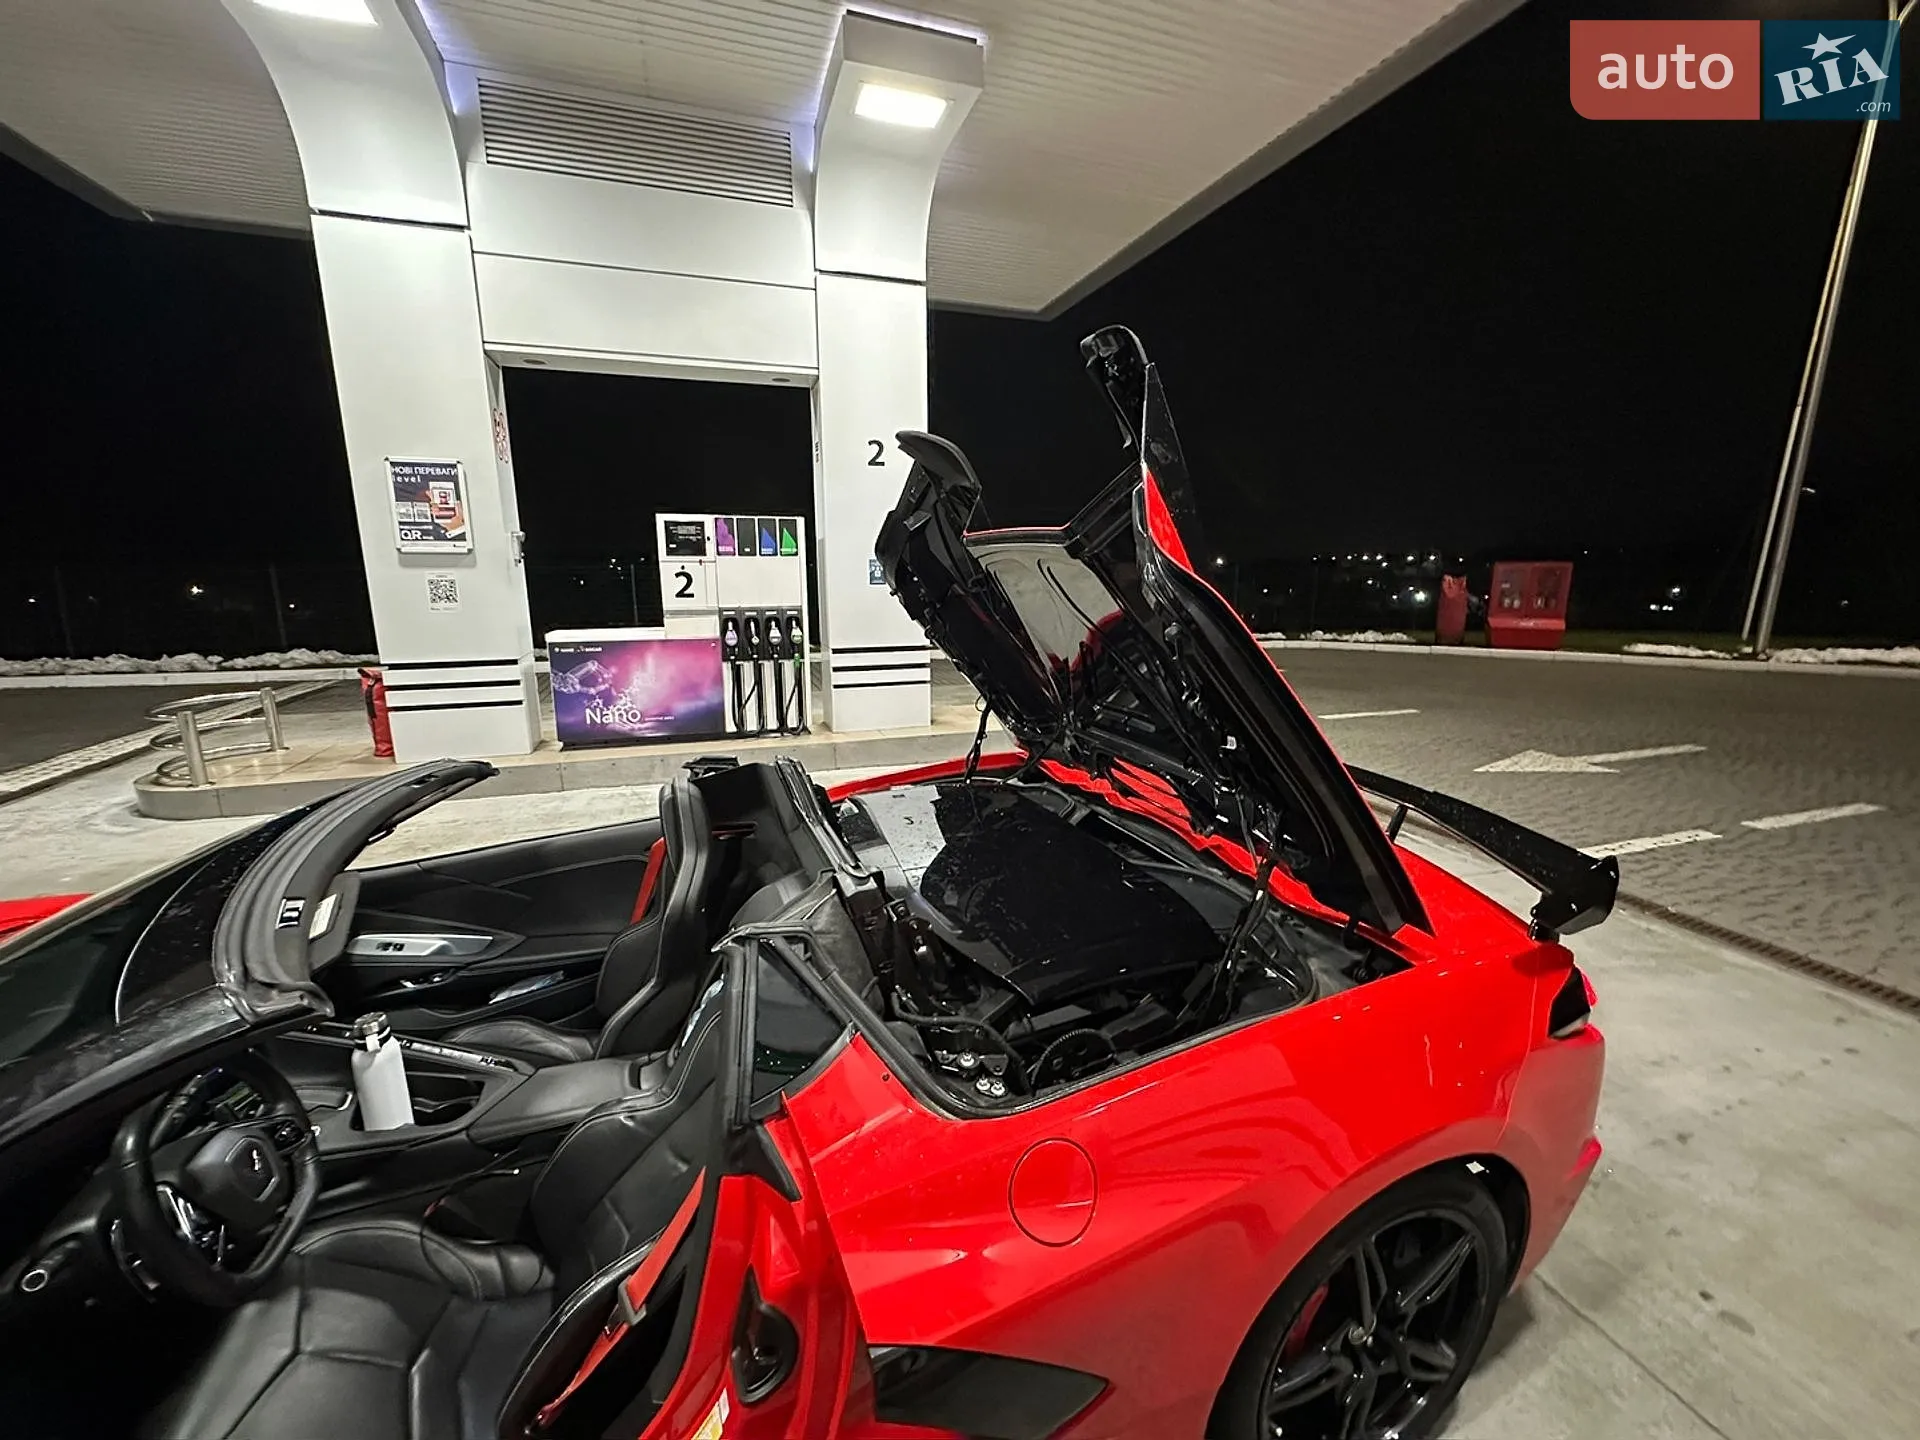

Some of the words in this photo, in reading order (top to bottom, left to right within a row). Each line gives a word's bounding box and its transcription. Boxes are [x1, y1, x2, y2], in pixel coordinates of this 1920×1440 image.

[868, 440, 885, 466] 2
[401, 530, 421, 540] QR
[674, 571, 695, 598] 2
[585, 706, 641, 725] Nano
